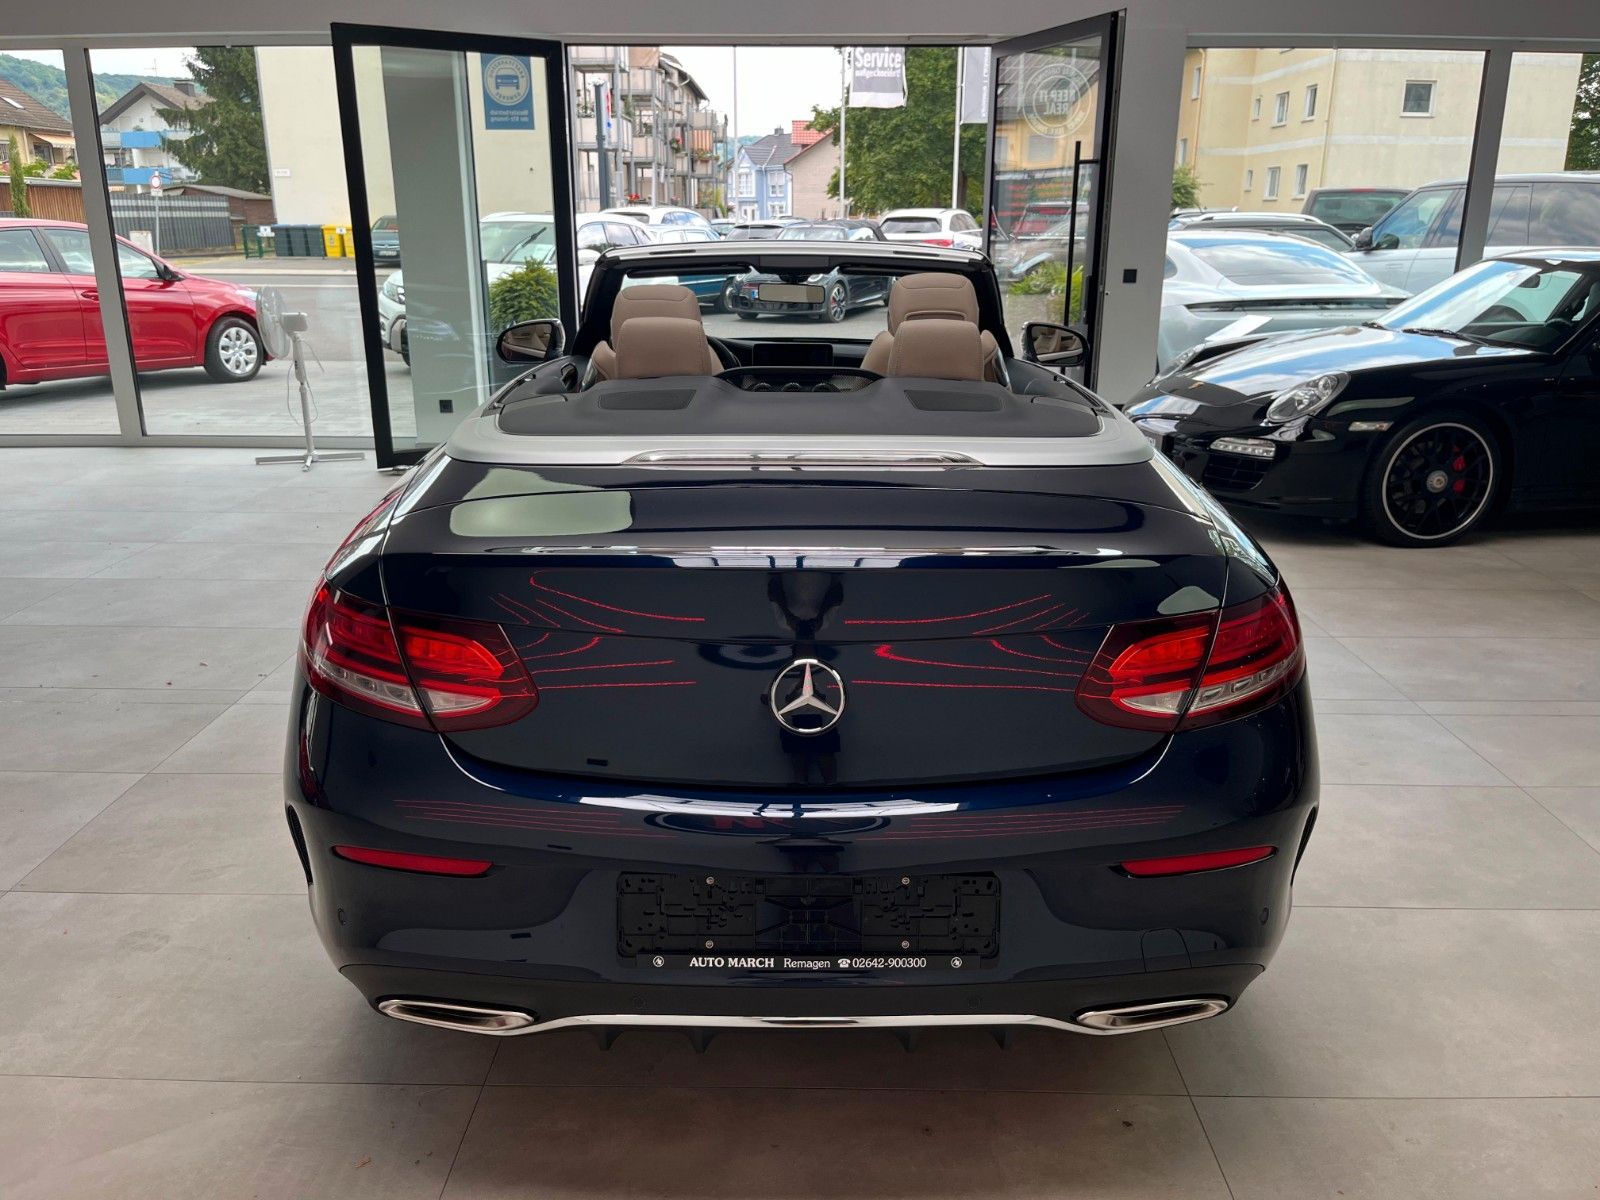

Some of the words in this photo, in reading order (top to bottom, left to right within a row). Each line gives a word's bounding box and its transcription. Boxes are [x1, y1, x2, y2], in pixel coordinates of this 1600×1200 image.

[855, 47, 901, 68] Service
[689, 956, 725, 968] AUTO
[727, 957, 775, 968] MARCH
[783, 957, 830, 970] Remagen
[852, 957, 927, 968] 02642-900300
